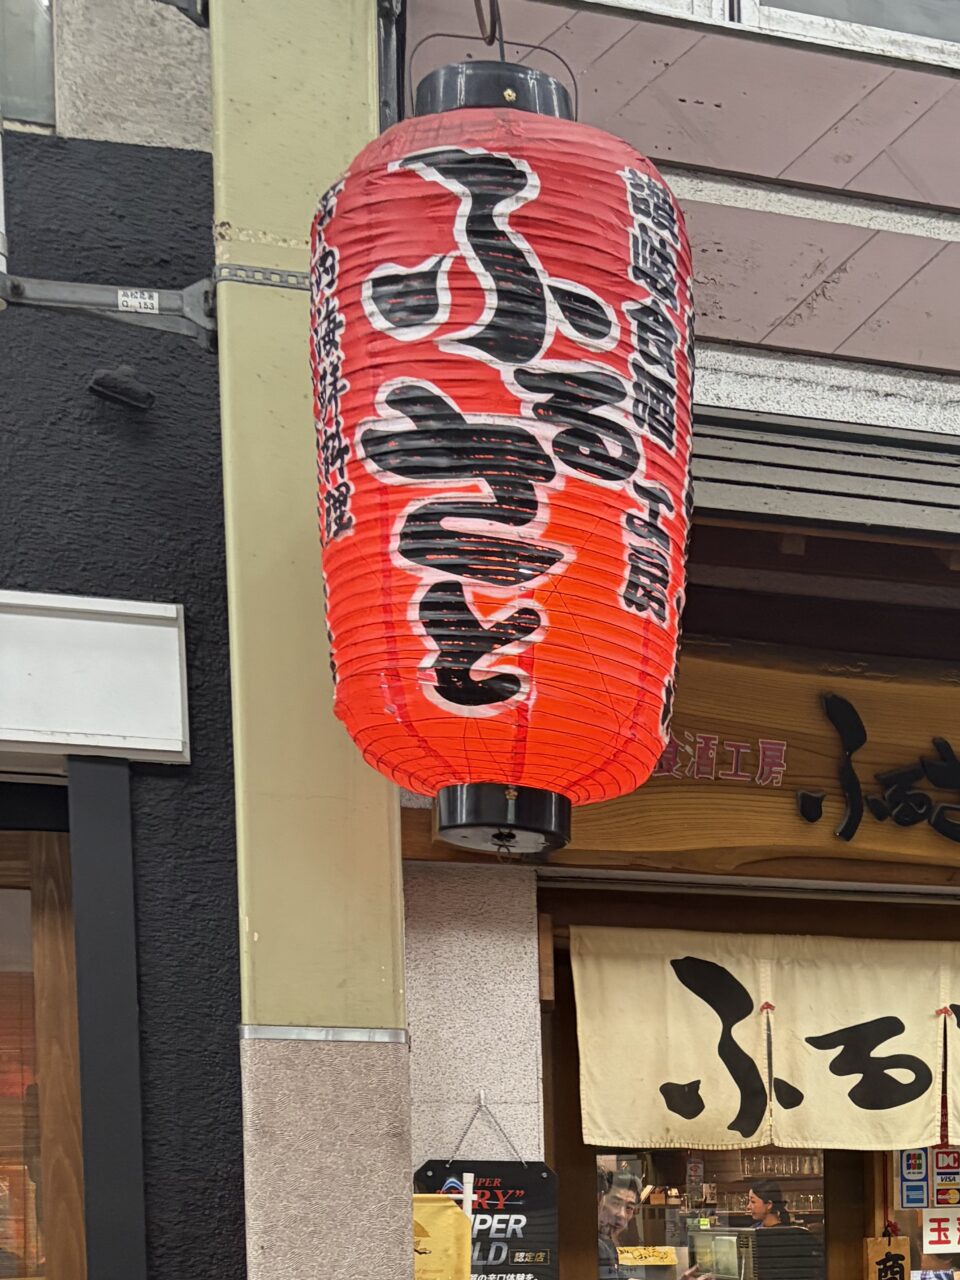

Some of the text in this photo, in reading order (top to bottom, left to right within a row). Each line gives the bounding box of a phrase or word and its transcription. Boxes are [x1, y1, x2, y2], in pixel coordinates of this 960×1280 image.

[362, 145, 636, 707] ふるさと
[940, 1175, 956, 1183] VISA
[513, 1252, 546, 1263] 認定店
